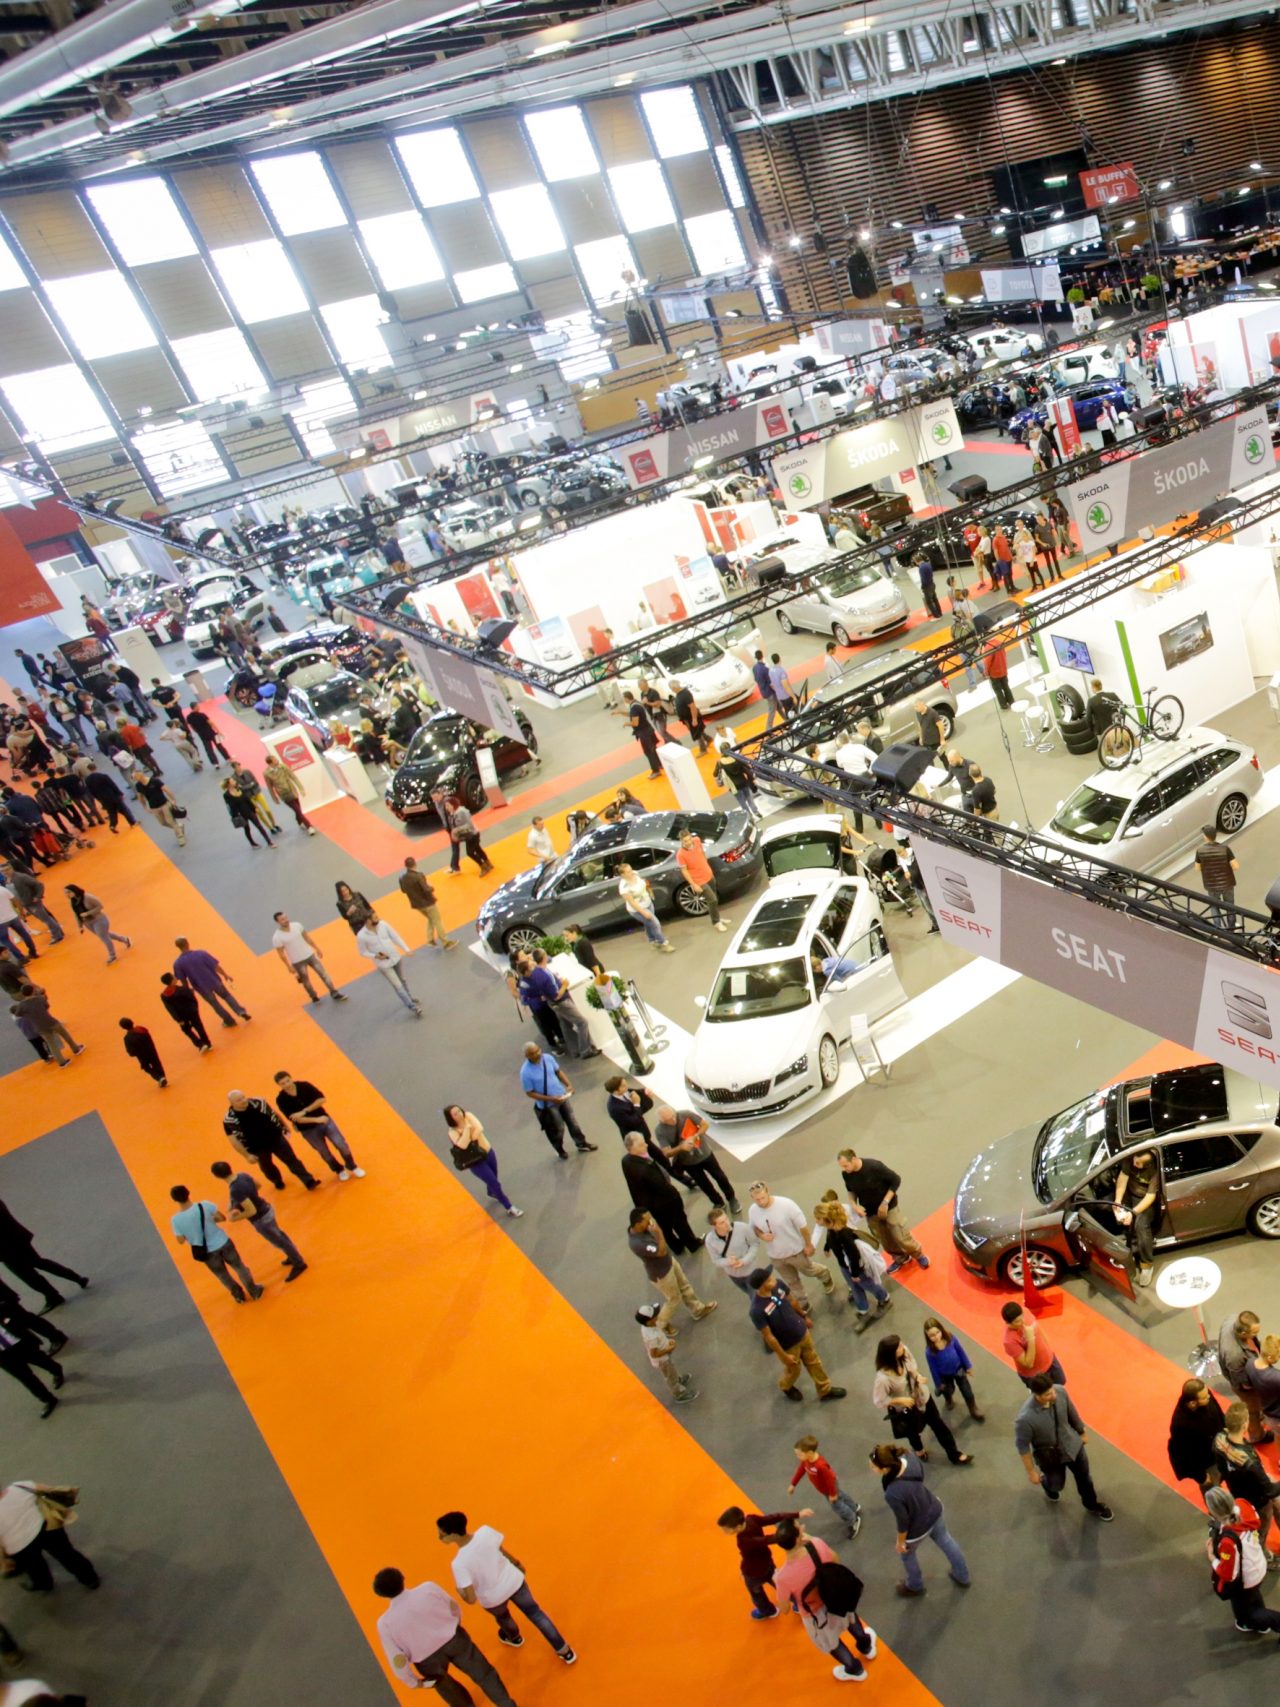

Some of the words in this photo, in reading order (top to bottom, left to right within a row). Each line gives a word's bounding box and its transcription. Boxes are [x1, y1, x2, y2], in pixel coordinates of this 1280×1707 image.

[1086, 176, 1097, 186] LE
[1098, 168, 1130, 184] BUFFET
[413, 413, 458, 437] NISSAN
[1236, 417, 1265, 435] ŠKODA
[686, 428, 740, 458] NISSAN
[846, 436, 901, 470] ŠKODA
[1153, 456, 1211, 496] ŠKODA
[1076, 482, 1110, 502] ŠKODA
[938, 907, 993, 940] SEAT
[1050, 926, 1128, 985] SEAT
